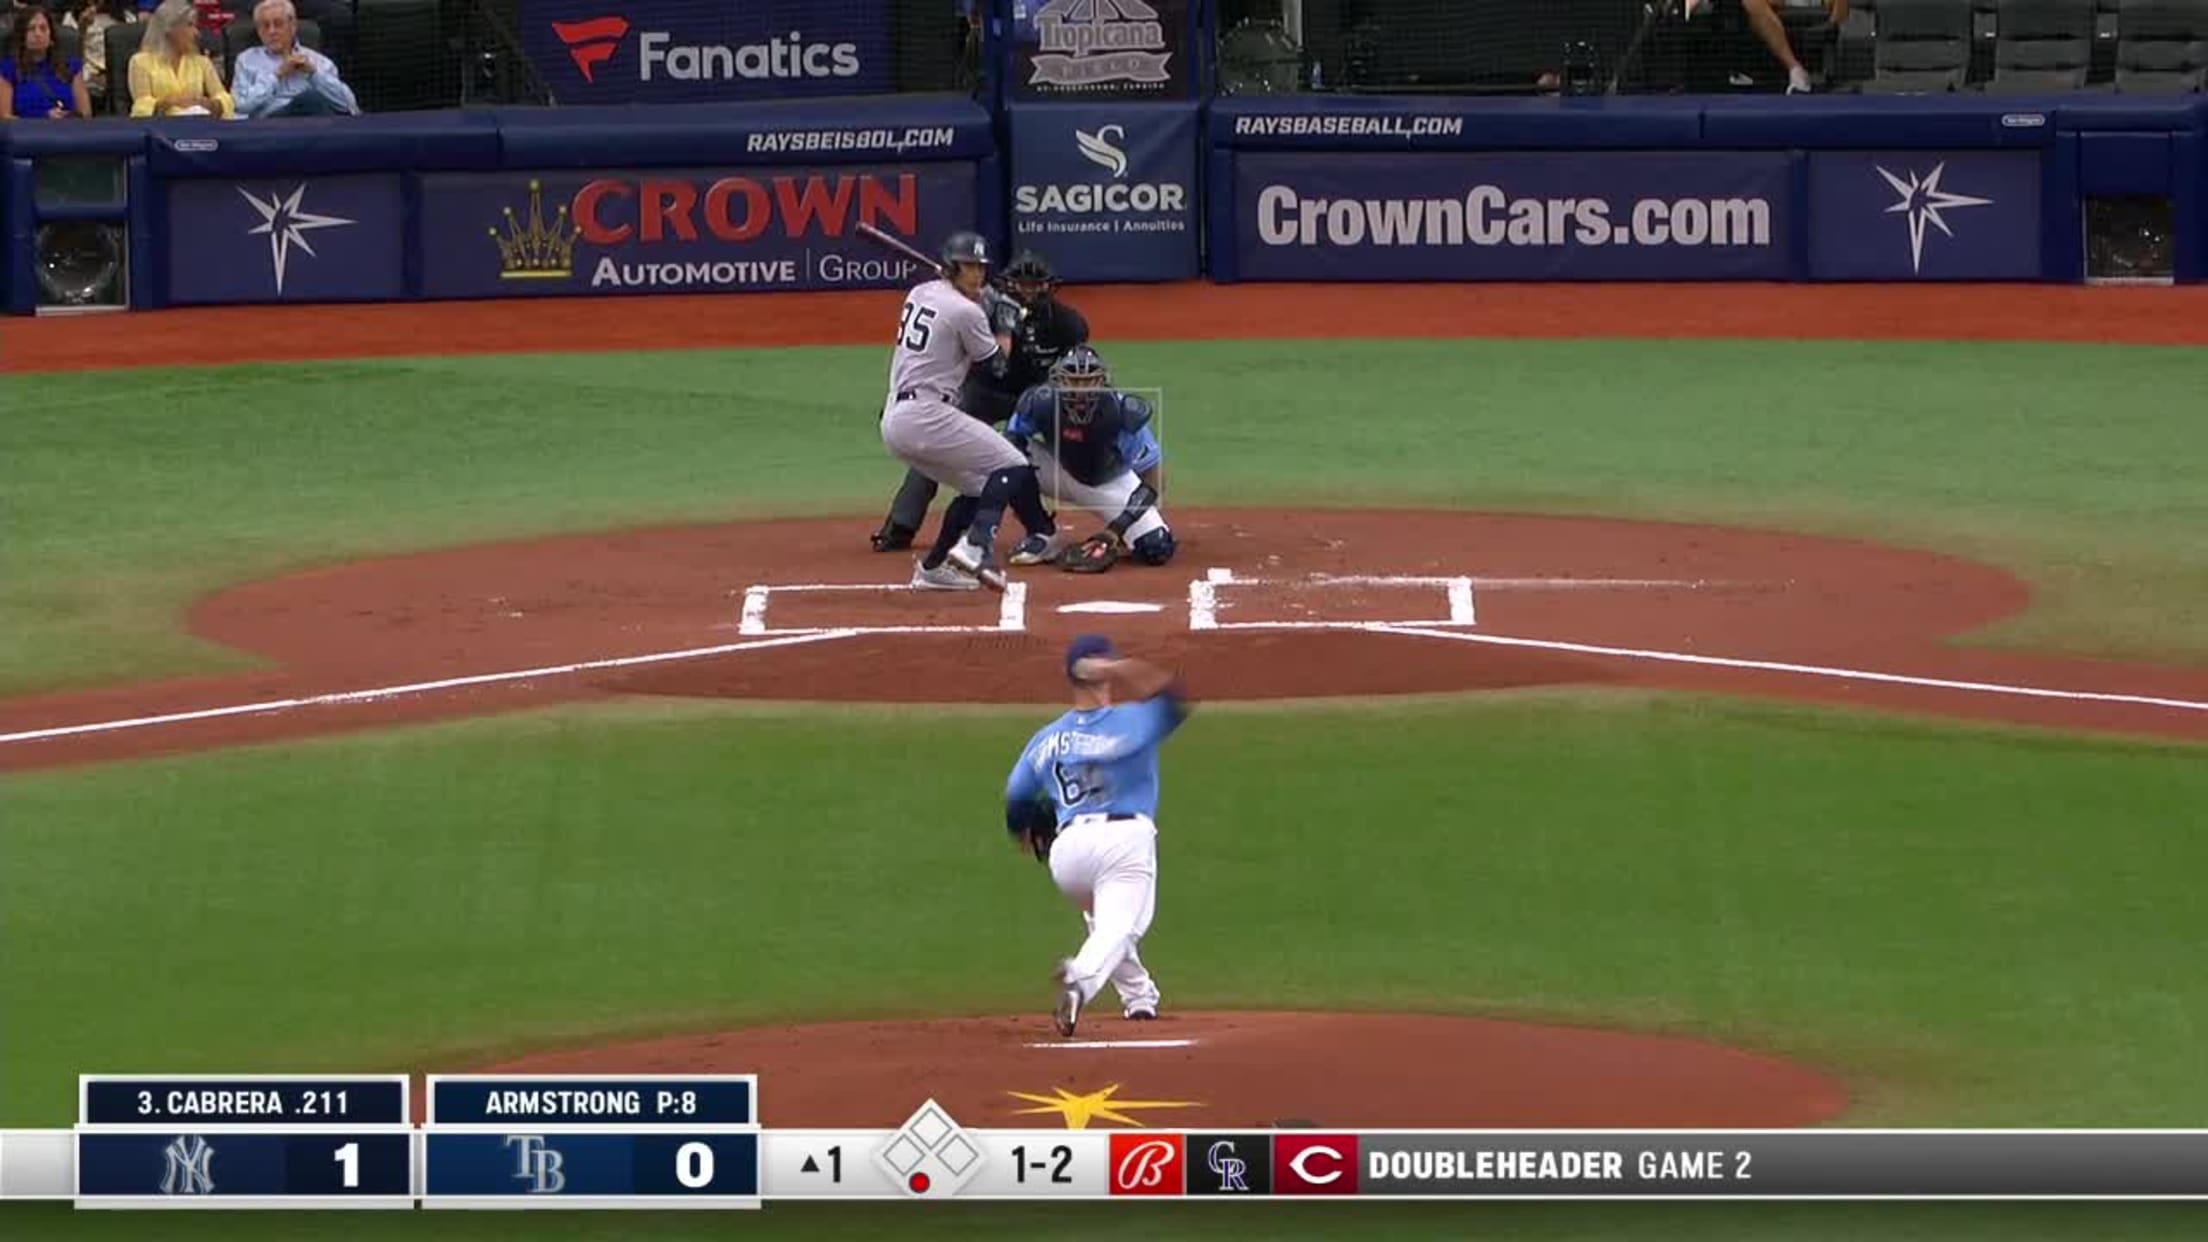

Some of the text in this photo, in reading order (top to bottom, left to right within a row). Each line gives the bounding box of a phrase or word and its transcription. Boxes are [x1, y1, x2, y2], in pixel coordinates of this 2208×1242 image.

[1035, 16, 1165, 57] Tropicana
[640, 31, 859, 81] Fanatics
[747, 128, 954, 152] RAYSBEISBOL.COM
[1235, 117, 1463, 138] RAYSBASEBALL.COM
[571, 173, 917, 244] CROWN
[1016, 183, 1184, 213] SAGICOR
[1018, 219, 1185, 233] Life Insurance Annuities
[1258, 184, 1770, 246] CrownCars.com
[592, 257, 796, 286] AUTOMOTIVE
